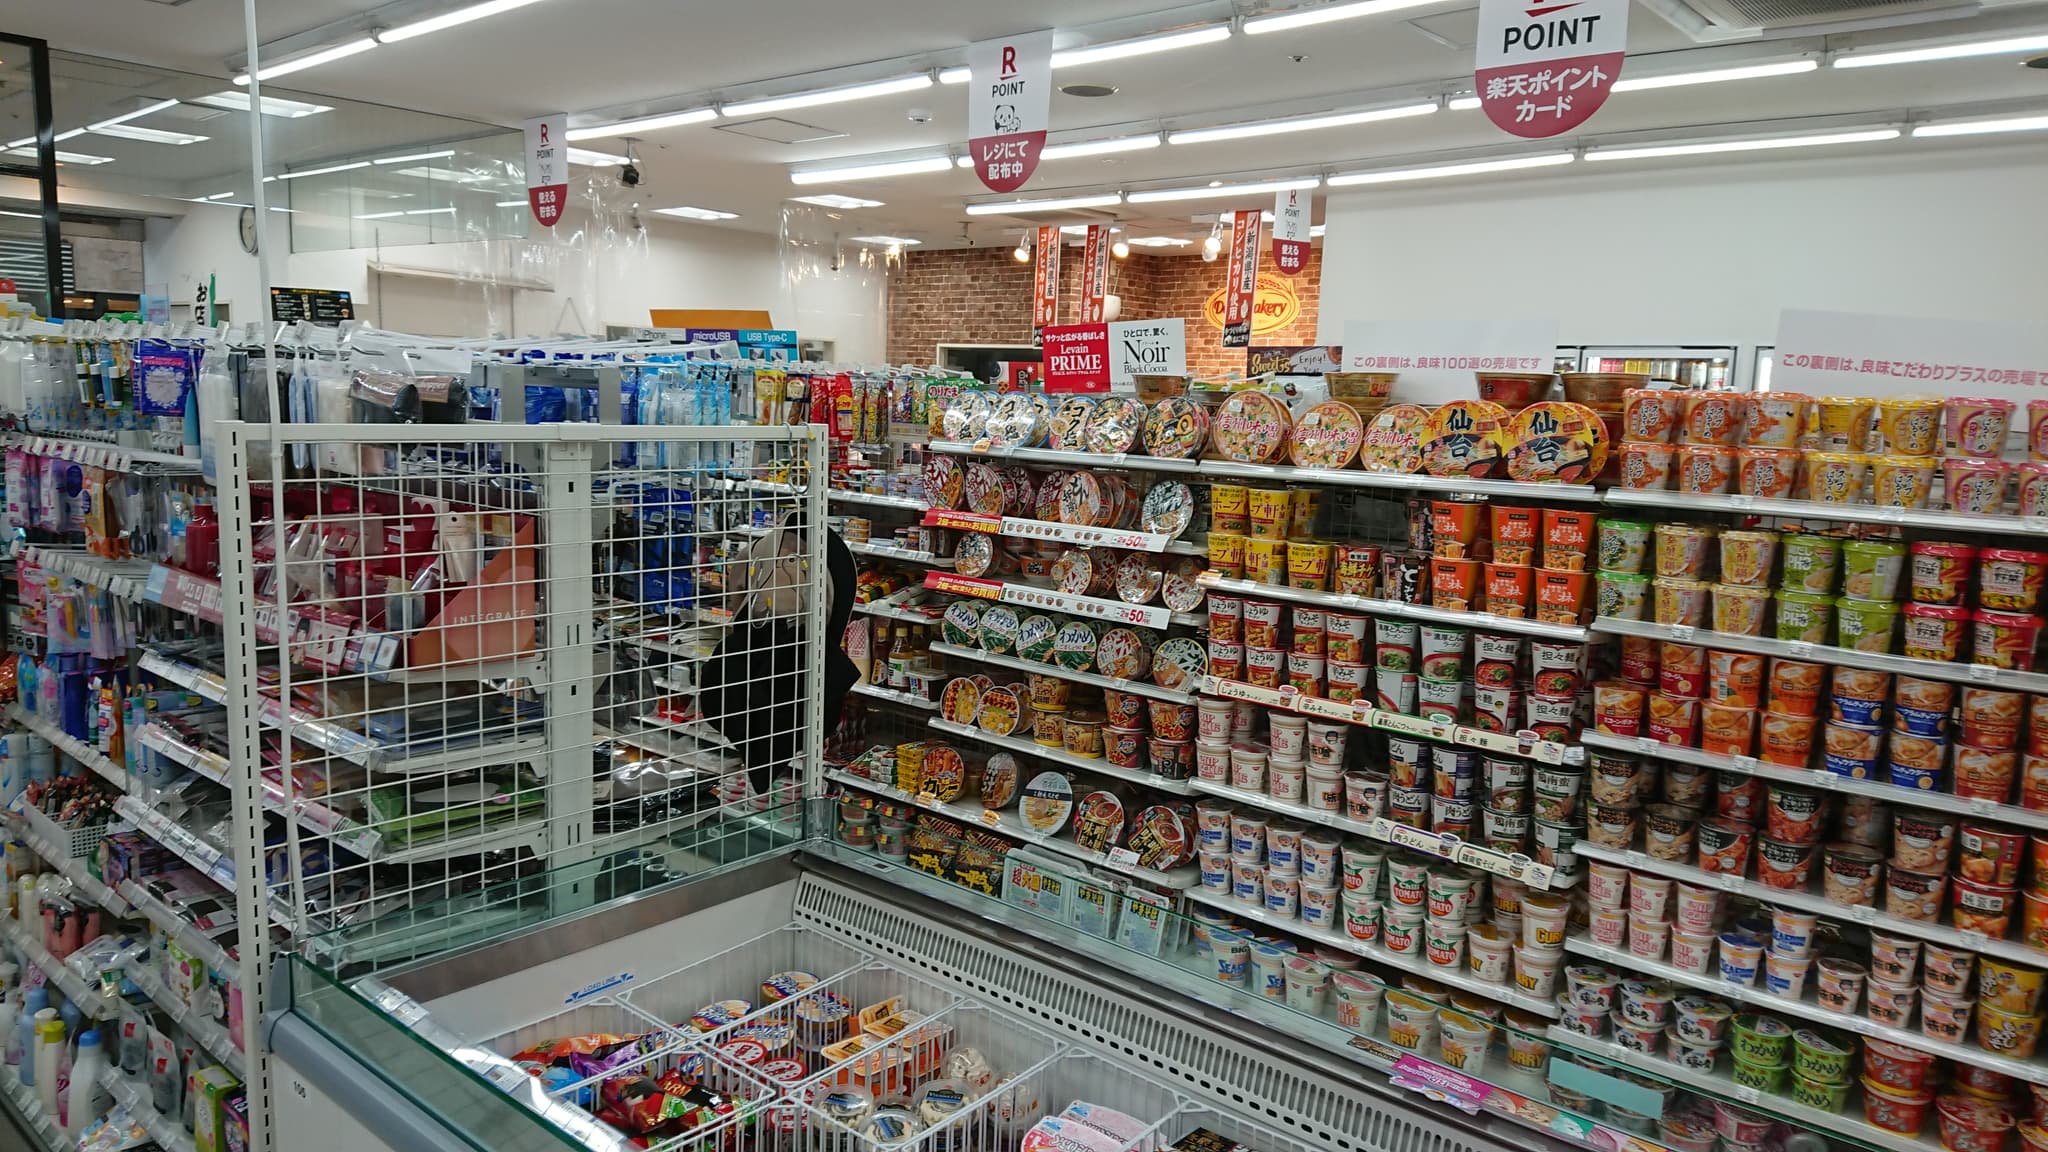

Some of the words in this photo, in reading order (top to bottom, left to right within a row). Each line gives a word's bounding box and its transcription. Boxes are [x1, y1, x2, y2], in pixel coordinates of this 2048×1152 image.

[1503, 15, 1601, 54] POINT
[1002, 46, 1017, 74] R
[992, 81, 1026, 98] POINT
[1486, 65, 1608, 99] 楽天ポイント
[1515, 95, 1574, 123] カード
[541, 123, 549, 143] R
[536, 148, 554, 160] POINT
[983, 140, 1029, 162] レジにて
[988, 160, 1024, 181] 配布中
[1290, 189, 1297, 204] R
[1285, 208, 1301, 218] POINT
[1241, 231, 1256, 291] 新潟県産
[1227, 219, 1245, 321] コシヒカリ使用
[692, 332, 731, 341] microUSB
[746, 332, 763, 341] USB
[764, 332, 788, 342] Type-C
[1060, 343, 1089, 355] Levain
[1123, 339, 1171, 364] Noir
[1050, 354, 1103, 371] PRIME
[1124, 365, 1143, 375] Black
[1144, 364, 1168, 373] Cocoa
[1353, 356, 1542, 370] この裏側は、良味100選の売場です
[1365, 429, 1420, 446] 信州味
[1445, 408, 1474, 459] 仙台
[1529, 410, 1561, 463] 仙台
[1211, 601, 1237, 610] しょうゆ
[1245, 606, 1269, 616] しょうゆ
[453, 608, 528, 624] INTEGRATE
[951, 604, 978, 630] わかめ
[1060, 629, 1093, 644] わかめ
[1213, 645, 1239, 655] しょうゆ
[1483, 641, 1515, 654] 担々麺
[1250, 653, 1276, 662] しょうゆ
[1542, 651, 1576, 663] 担々麺
[1221, 686, 1245, 696] しょうゆ
[1421, 682, 1457, 693] 濃厚とんこつ
[1536, 704, 1569, 717] 担々麺
[1459, 734, 1488, 746] 担々麺
[922, 777, 960, 800] カレー
[1392, 792, 1422, 806] 肉うどん
[1393, 833, 1424, 849] 肉うどん
[1461, 853, 1496, 870] 鴨南蛮そば
[1042, 876, 1061, 896] やきそば
[1078, 887, 1105, 905] やきそば
[1131, 900, 1159, 920] やきそば
[583, 979, 599, 993] LOAD
[600, 975, 617, 988] LINE
